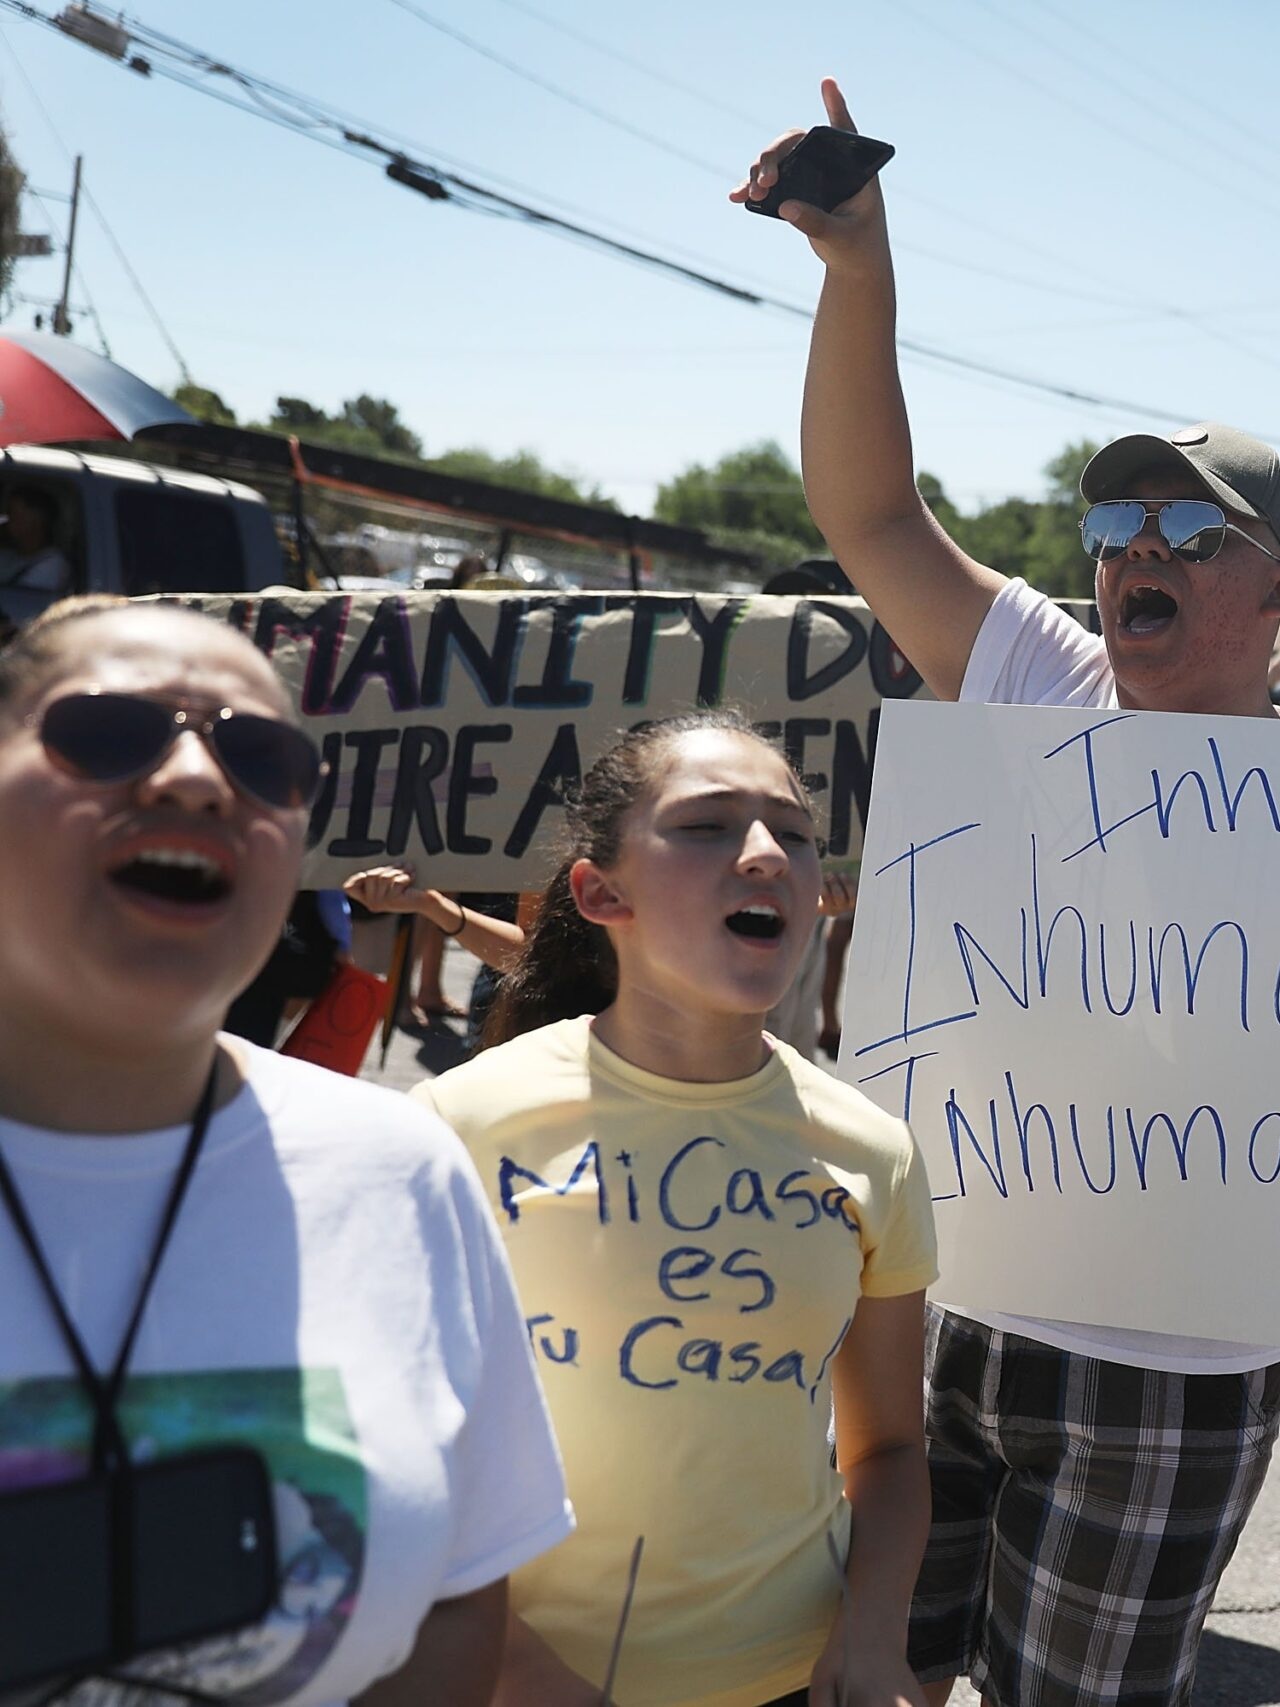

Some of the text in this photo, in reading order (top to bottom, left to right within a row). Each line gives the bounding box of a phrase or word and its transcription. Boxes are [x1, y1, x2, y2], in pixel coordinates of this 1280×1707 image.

[232, 597, 748, 714] MANITY
[498, 1135, 862, 1232] Mi Casa
[658, 1245, 777, 1313] es
